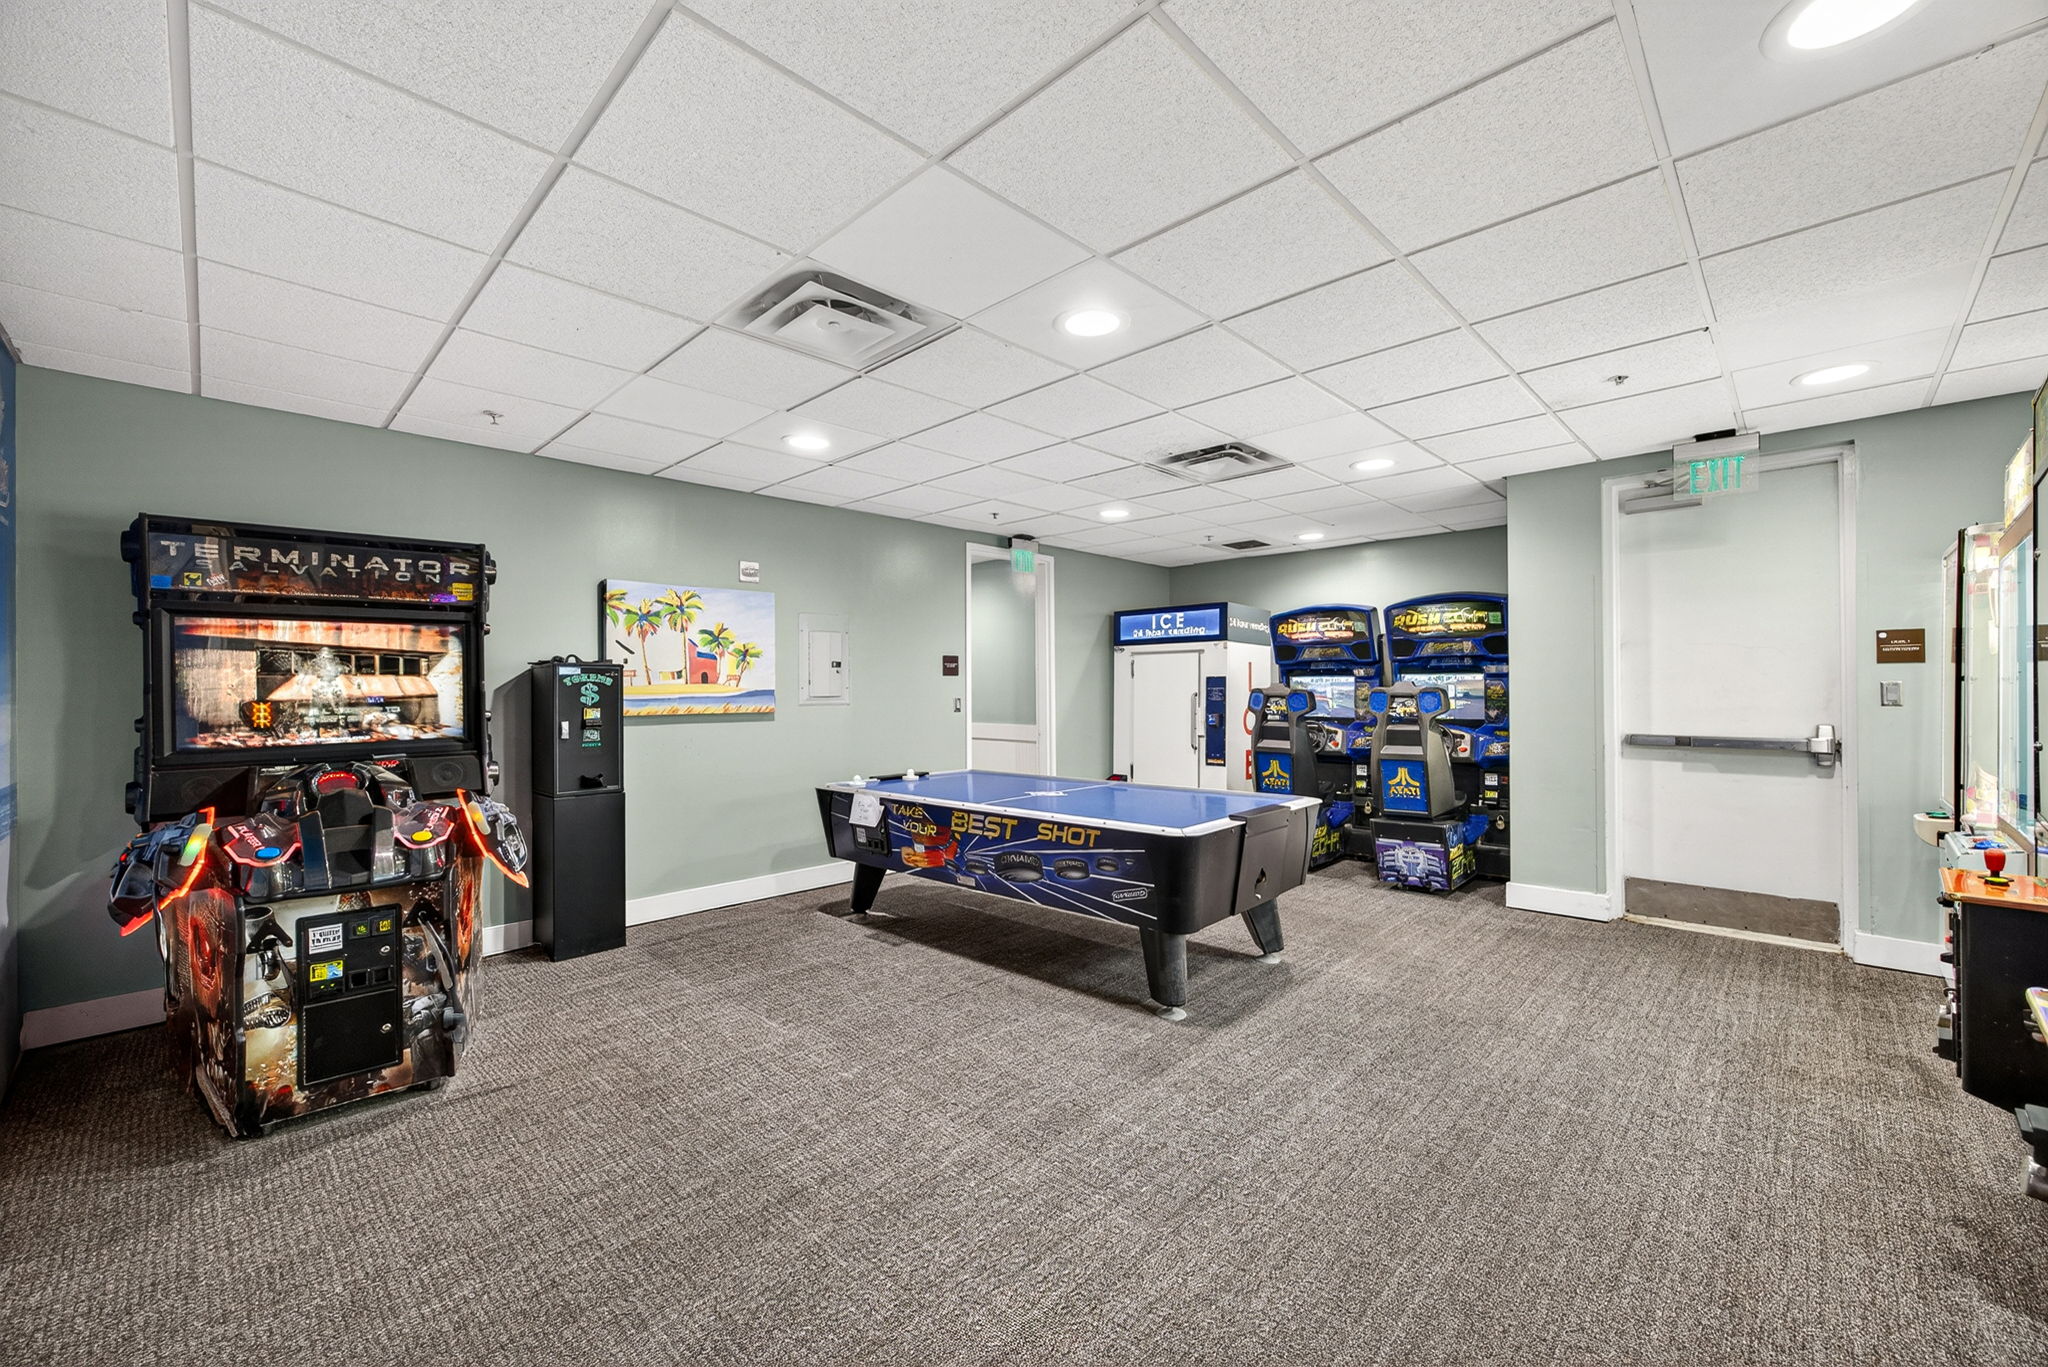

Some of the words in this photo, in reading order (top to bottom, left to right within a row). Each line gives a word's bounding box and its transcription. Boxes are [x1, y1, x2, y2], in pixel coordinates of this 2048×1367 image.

[1690, 456, 1744, 494] EXIT
[160, 540, 473, 577] TERMINATOR
[196, 559, 440, 583] SALVATION
[1152, 612, 1185, 629] ICE
[1394, 610, 1441, 627] RUSH
[562, 673, 614, 687] TOKENS
[580, 682, 600, 706] $
[1389, 785, 1421, 796] ATARI
[891, 803, 924, 819] TAKE
[902, 818, 937, 837] YOUR
[950, 810, 1019, 840] BEST
[1037, 822, 1101, 848] SHOT
